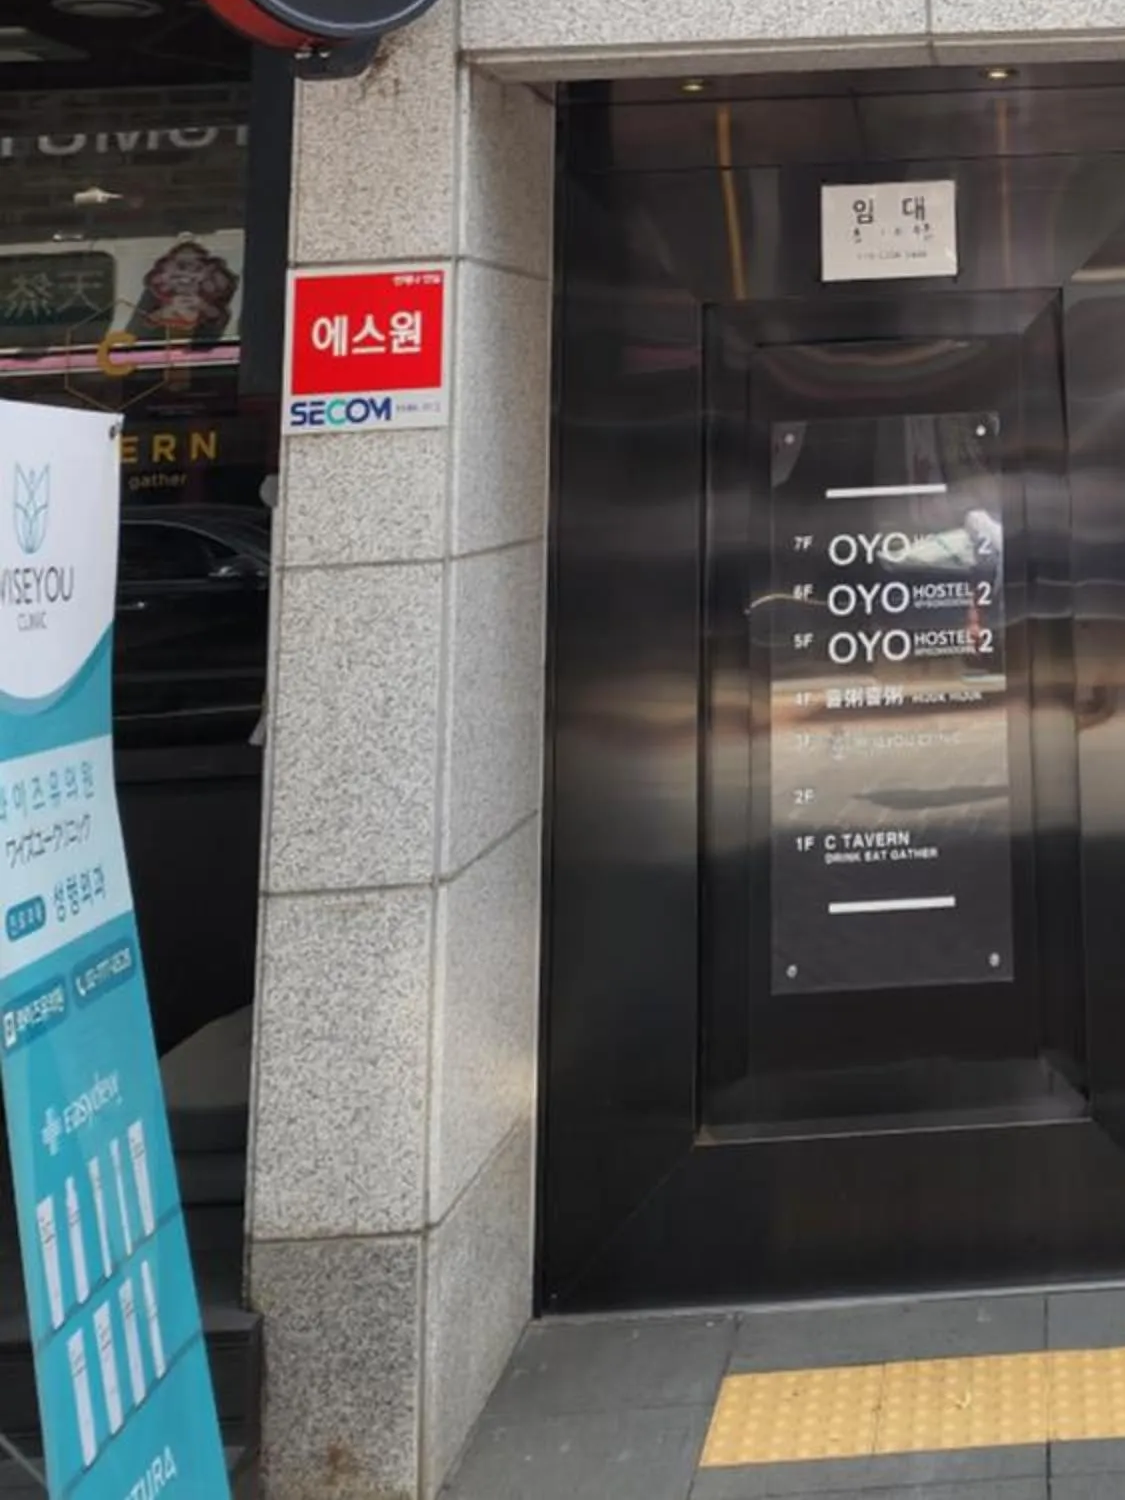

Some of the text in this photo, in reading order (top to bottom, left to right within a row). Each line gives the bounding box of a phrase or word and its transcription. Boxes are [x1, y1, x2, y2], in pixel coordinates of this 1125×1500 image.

[311, 310, 423, 358] 에스원
[290, 397, 392, 427] SECOM
[129, 472, 188, 491] gather
[829, 532, 911, 566] OYO
[828, 581, 910, 616] OYO
[913, 583, 973, 598] HOSTEL
[975, 582, 992, 606] 2
[794, 629, 994, 663] 5F OYO HOSTEL 2
[793, 789, 815, 805] 2F
[796, 831, 910, 851] 1F C TAVERN
[825, 847, 938, 864] DRINK EAT GATHER
